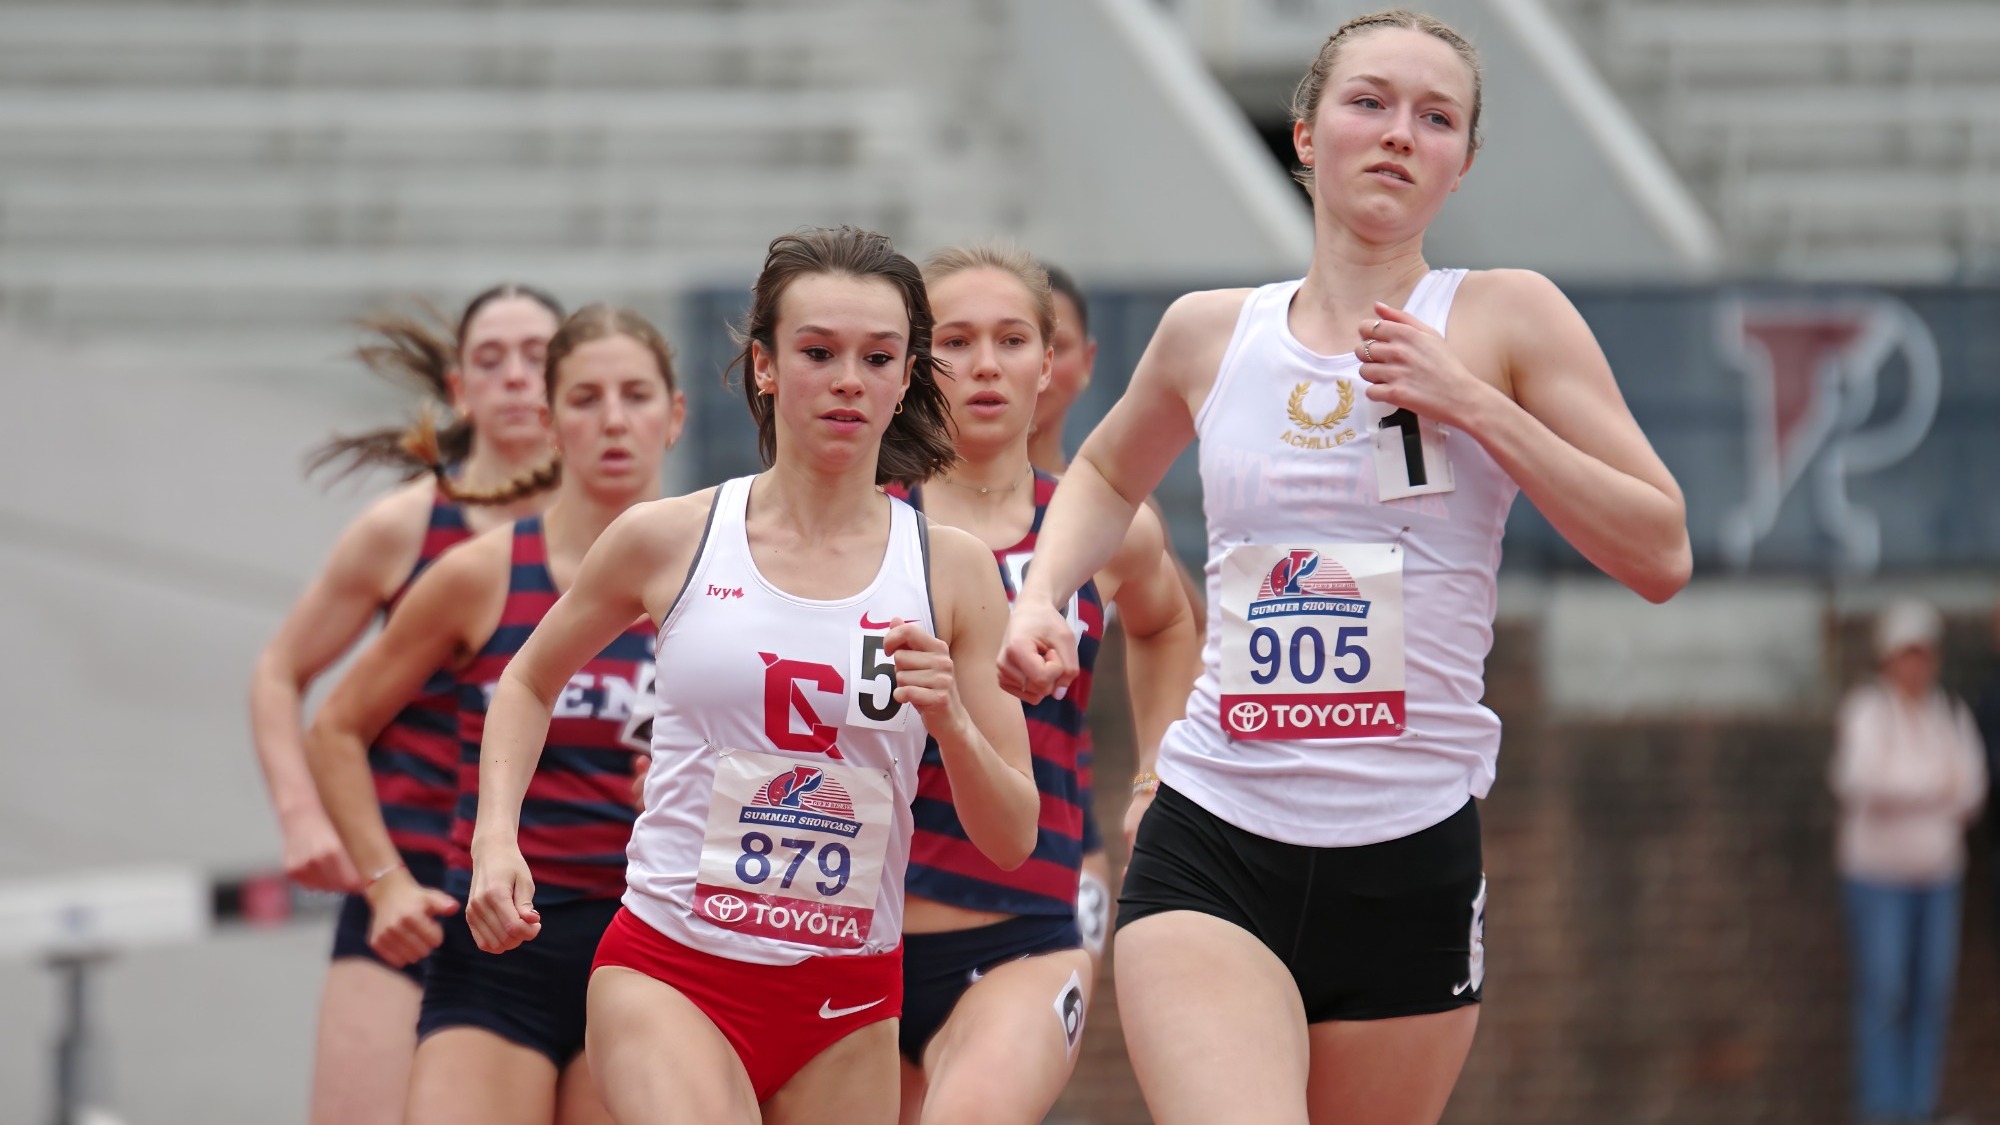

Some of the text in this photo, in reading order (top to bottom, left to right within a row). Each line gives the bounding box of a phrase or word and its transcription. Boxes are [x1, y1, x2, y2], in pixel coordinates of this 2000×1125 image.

[1280, 429, 1357, 450] ACHILLES
[1379, 407, 1427, 487] 1
[706, 584, 731, 600] Ivy
[1252, 599, 1366, 615] SUMMER SHOWCASE
[1249, 626, 1371, 685] 905
[858, 635, 902, 722] 5
[1271, 702, 1395, 728] TOYOTA
[743, 811, 856, 833] SUMMER SHOWCASE
[735, 831, 851, 897] 879
[752, 903, 860, 939] TOYOTA
